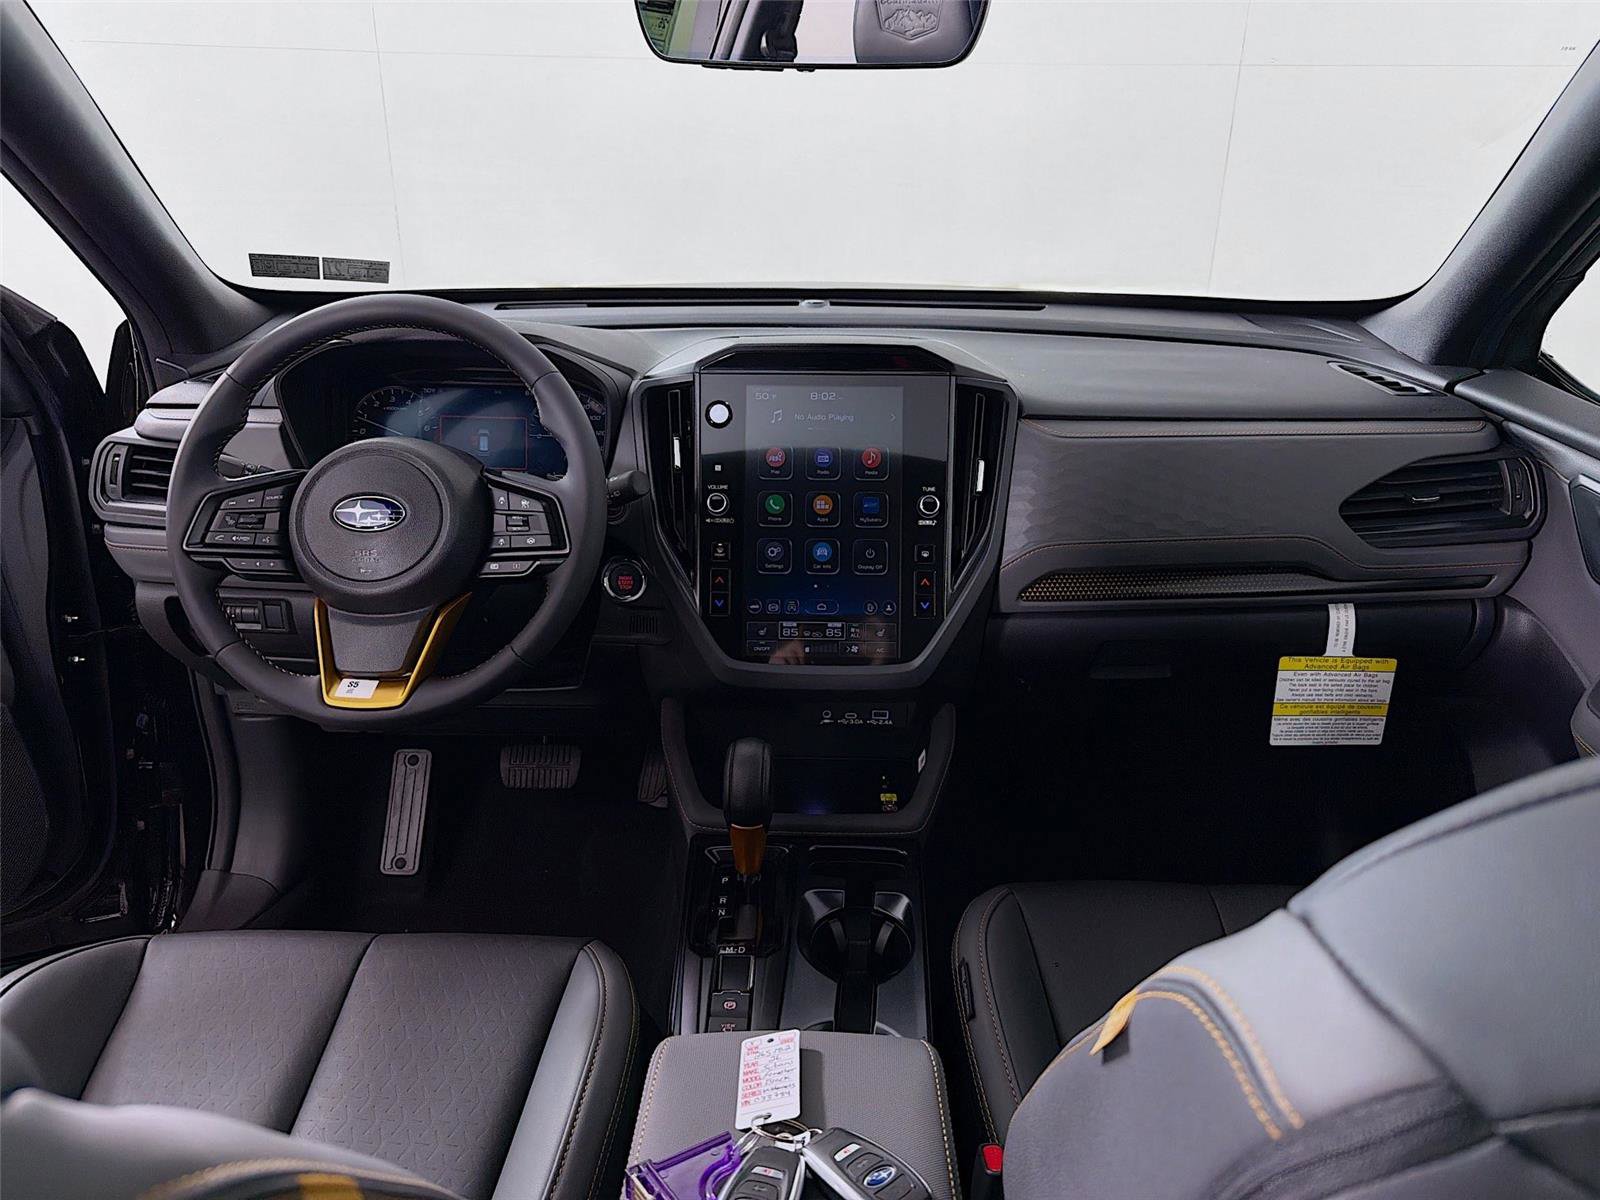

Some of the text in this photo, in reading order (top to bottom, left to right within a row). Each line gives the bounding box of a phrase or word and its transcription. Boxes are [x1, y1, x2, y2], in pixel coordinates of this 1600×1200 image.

[810, 392, 837, 401] 8:02
[794, 413, 855, 423] No Audio Playing
[782, 628, 799, 636] 85
[825, 628, 842, 637] 85
[737, 946, 746, 954] D
